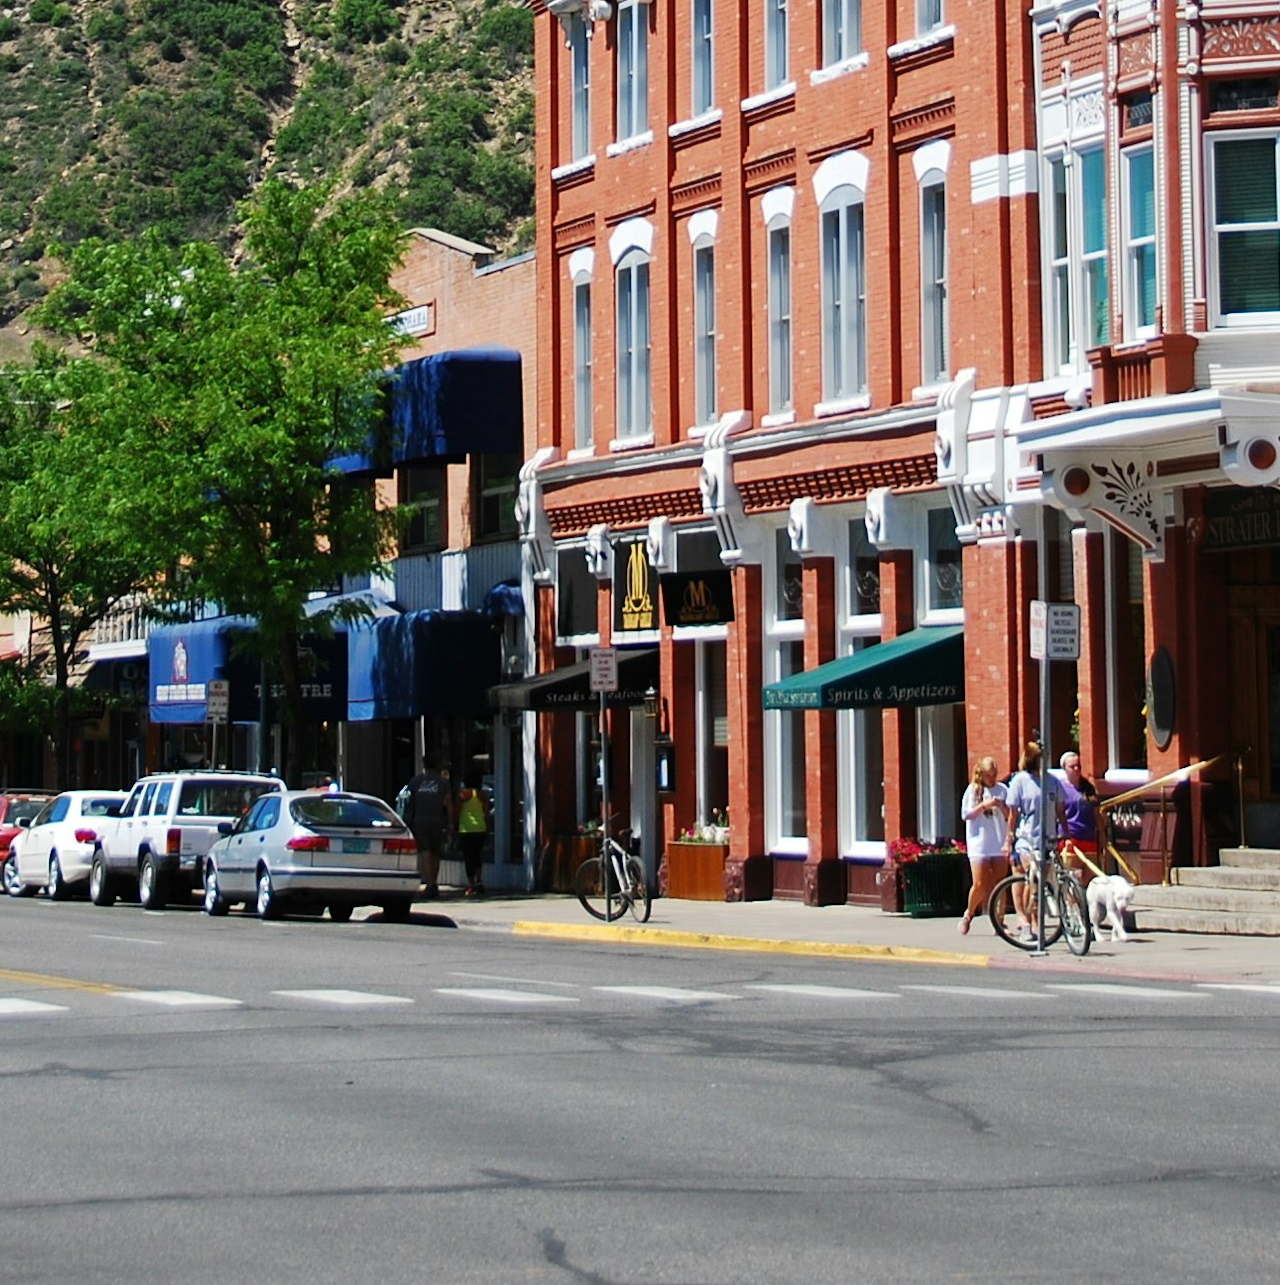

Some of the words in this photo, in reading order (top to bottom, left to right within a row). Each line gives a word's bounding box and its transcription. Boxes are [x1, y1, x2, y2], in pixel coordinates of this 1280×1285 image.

[1209, 511, 1271, 546] STRATER
[546, 691, 585, 703] Steaks
[827, 688, 869, 704] Spirits
[873, 687, 883, 699] &
[887, 684, 957, 702] Appetizers
